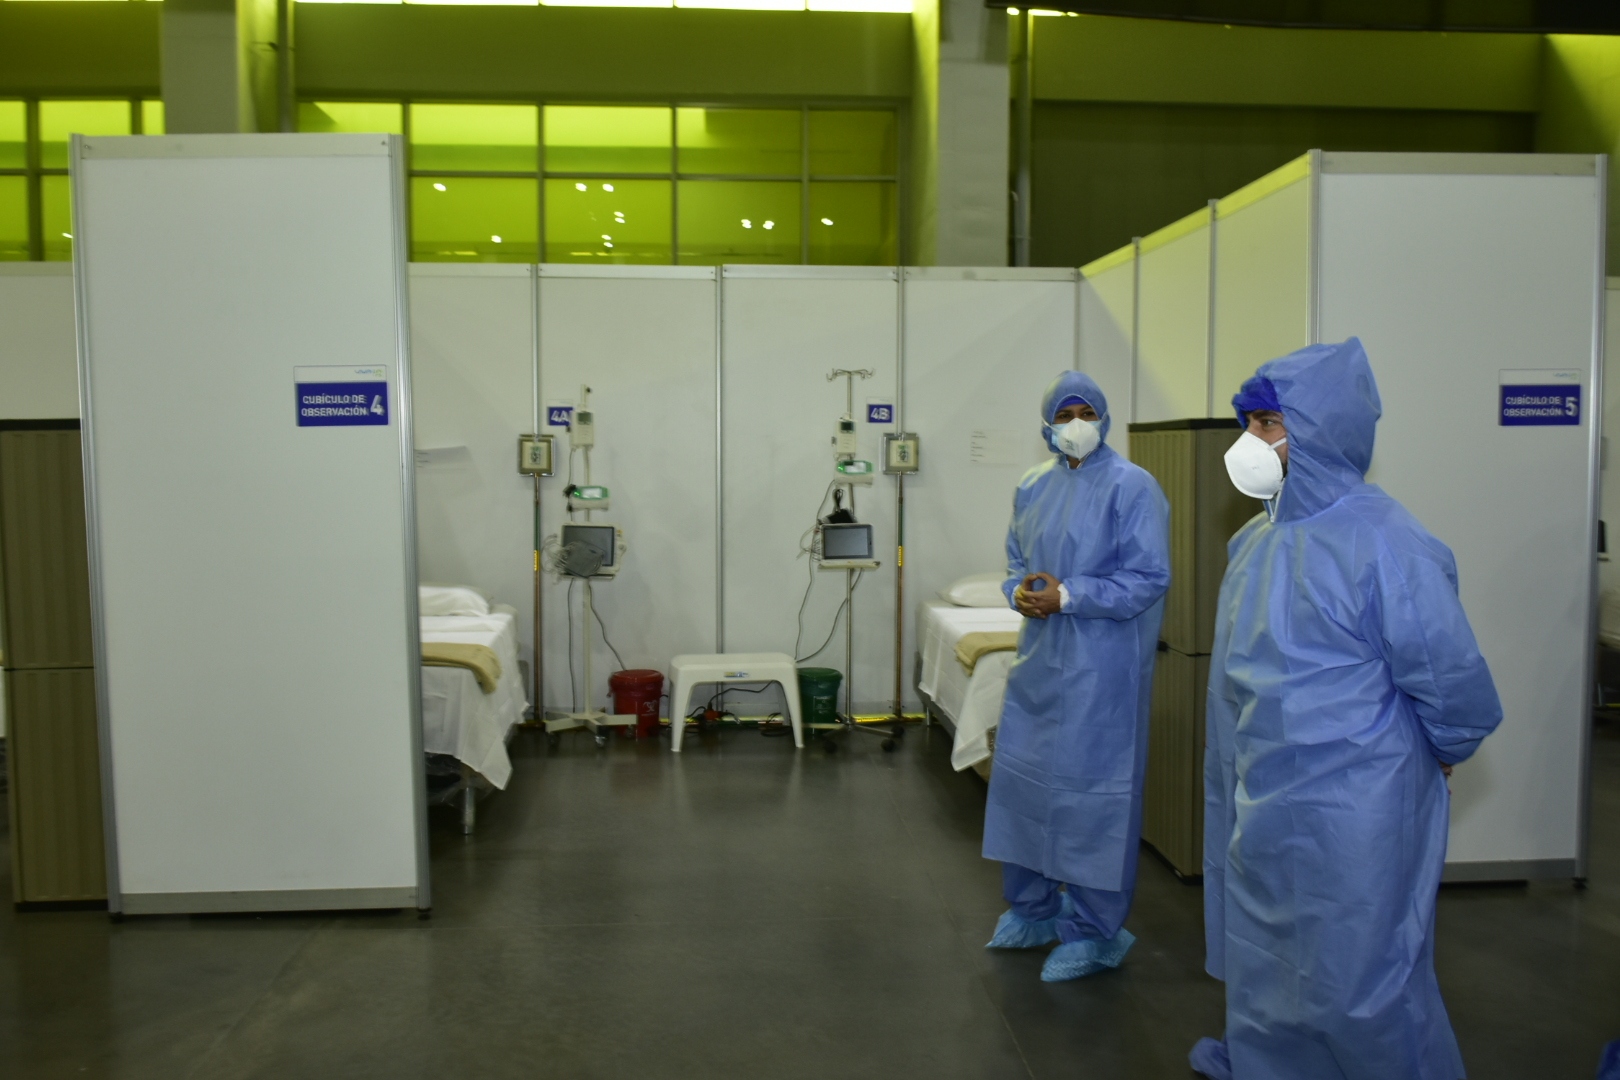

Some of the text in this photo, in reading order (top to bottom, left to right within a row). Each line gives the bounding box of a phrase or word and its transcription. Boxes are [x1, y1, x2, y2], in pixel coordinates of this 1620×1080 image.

[302, 393, 366, 404] CUBÍCULO DE
[1505, 394, 1562, 405] CUBÍCULO DE
[301, 405, 368, 417] OBSERVACIÓN
[370, 394, 384, 416] 4
[1565, 397, 1578, 417] 5
[550, 410, 570, 422] 4A
[870, 407, 890, 421] 4B
[1503, 406, 1564, 417] OBSERVACIÓN
